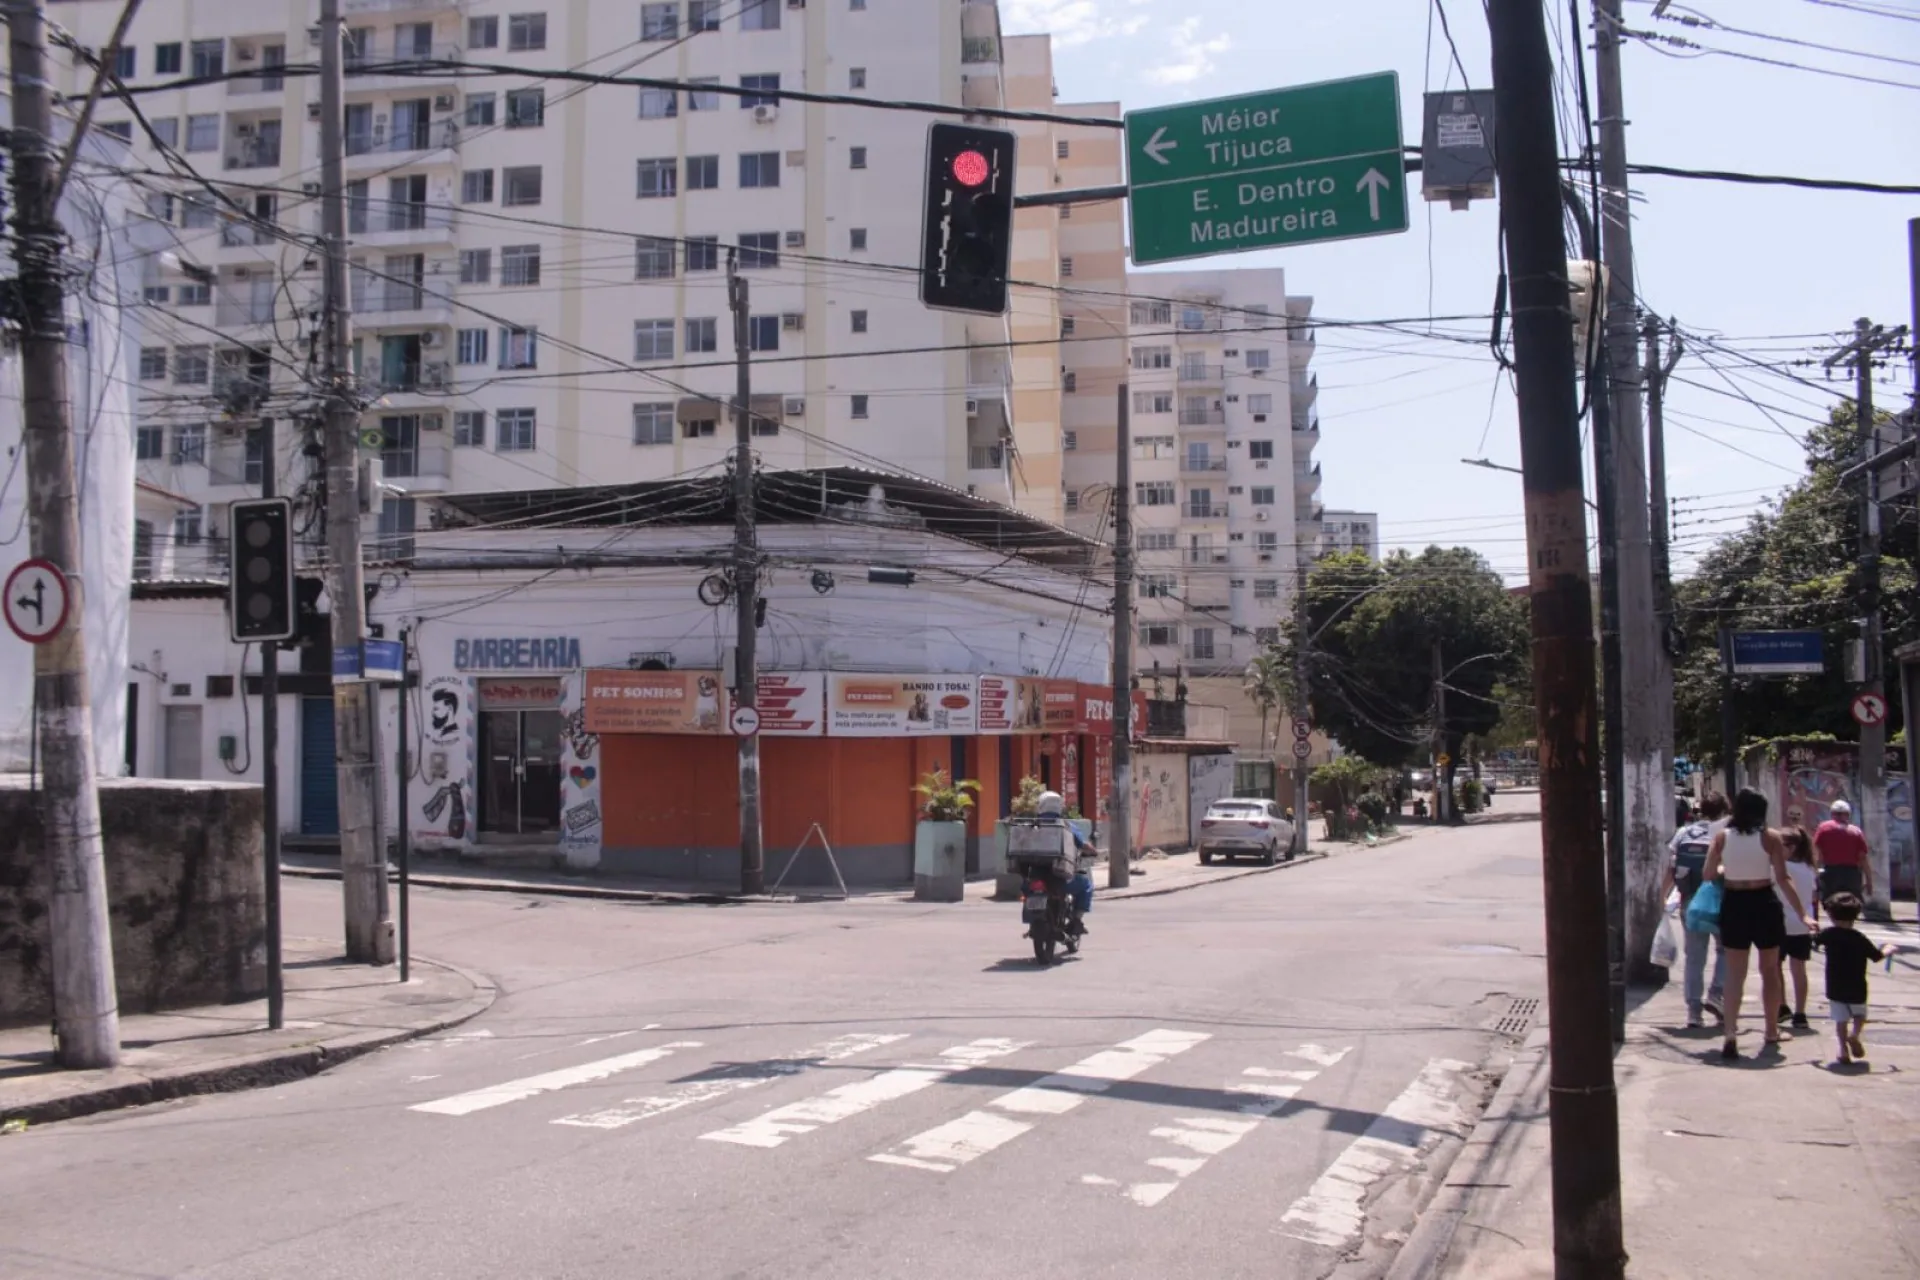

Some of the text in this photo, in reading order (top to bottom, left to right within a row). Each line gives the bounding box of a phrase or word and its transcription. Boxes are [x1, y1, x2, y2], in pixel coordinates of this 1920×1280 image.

[1201, 106, 1280, 135] Méier
[1204, 135, 1292, 166] Tijuca
[1192, 174, 1336, 213] E. Dentro
[1190, 207, 1338, 244] Madureira
[454, 636, 581, 669] BARBEARIA
[592, 686, 621, 698] PET
[1085, 698, 1103, 721] PET
